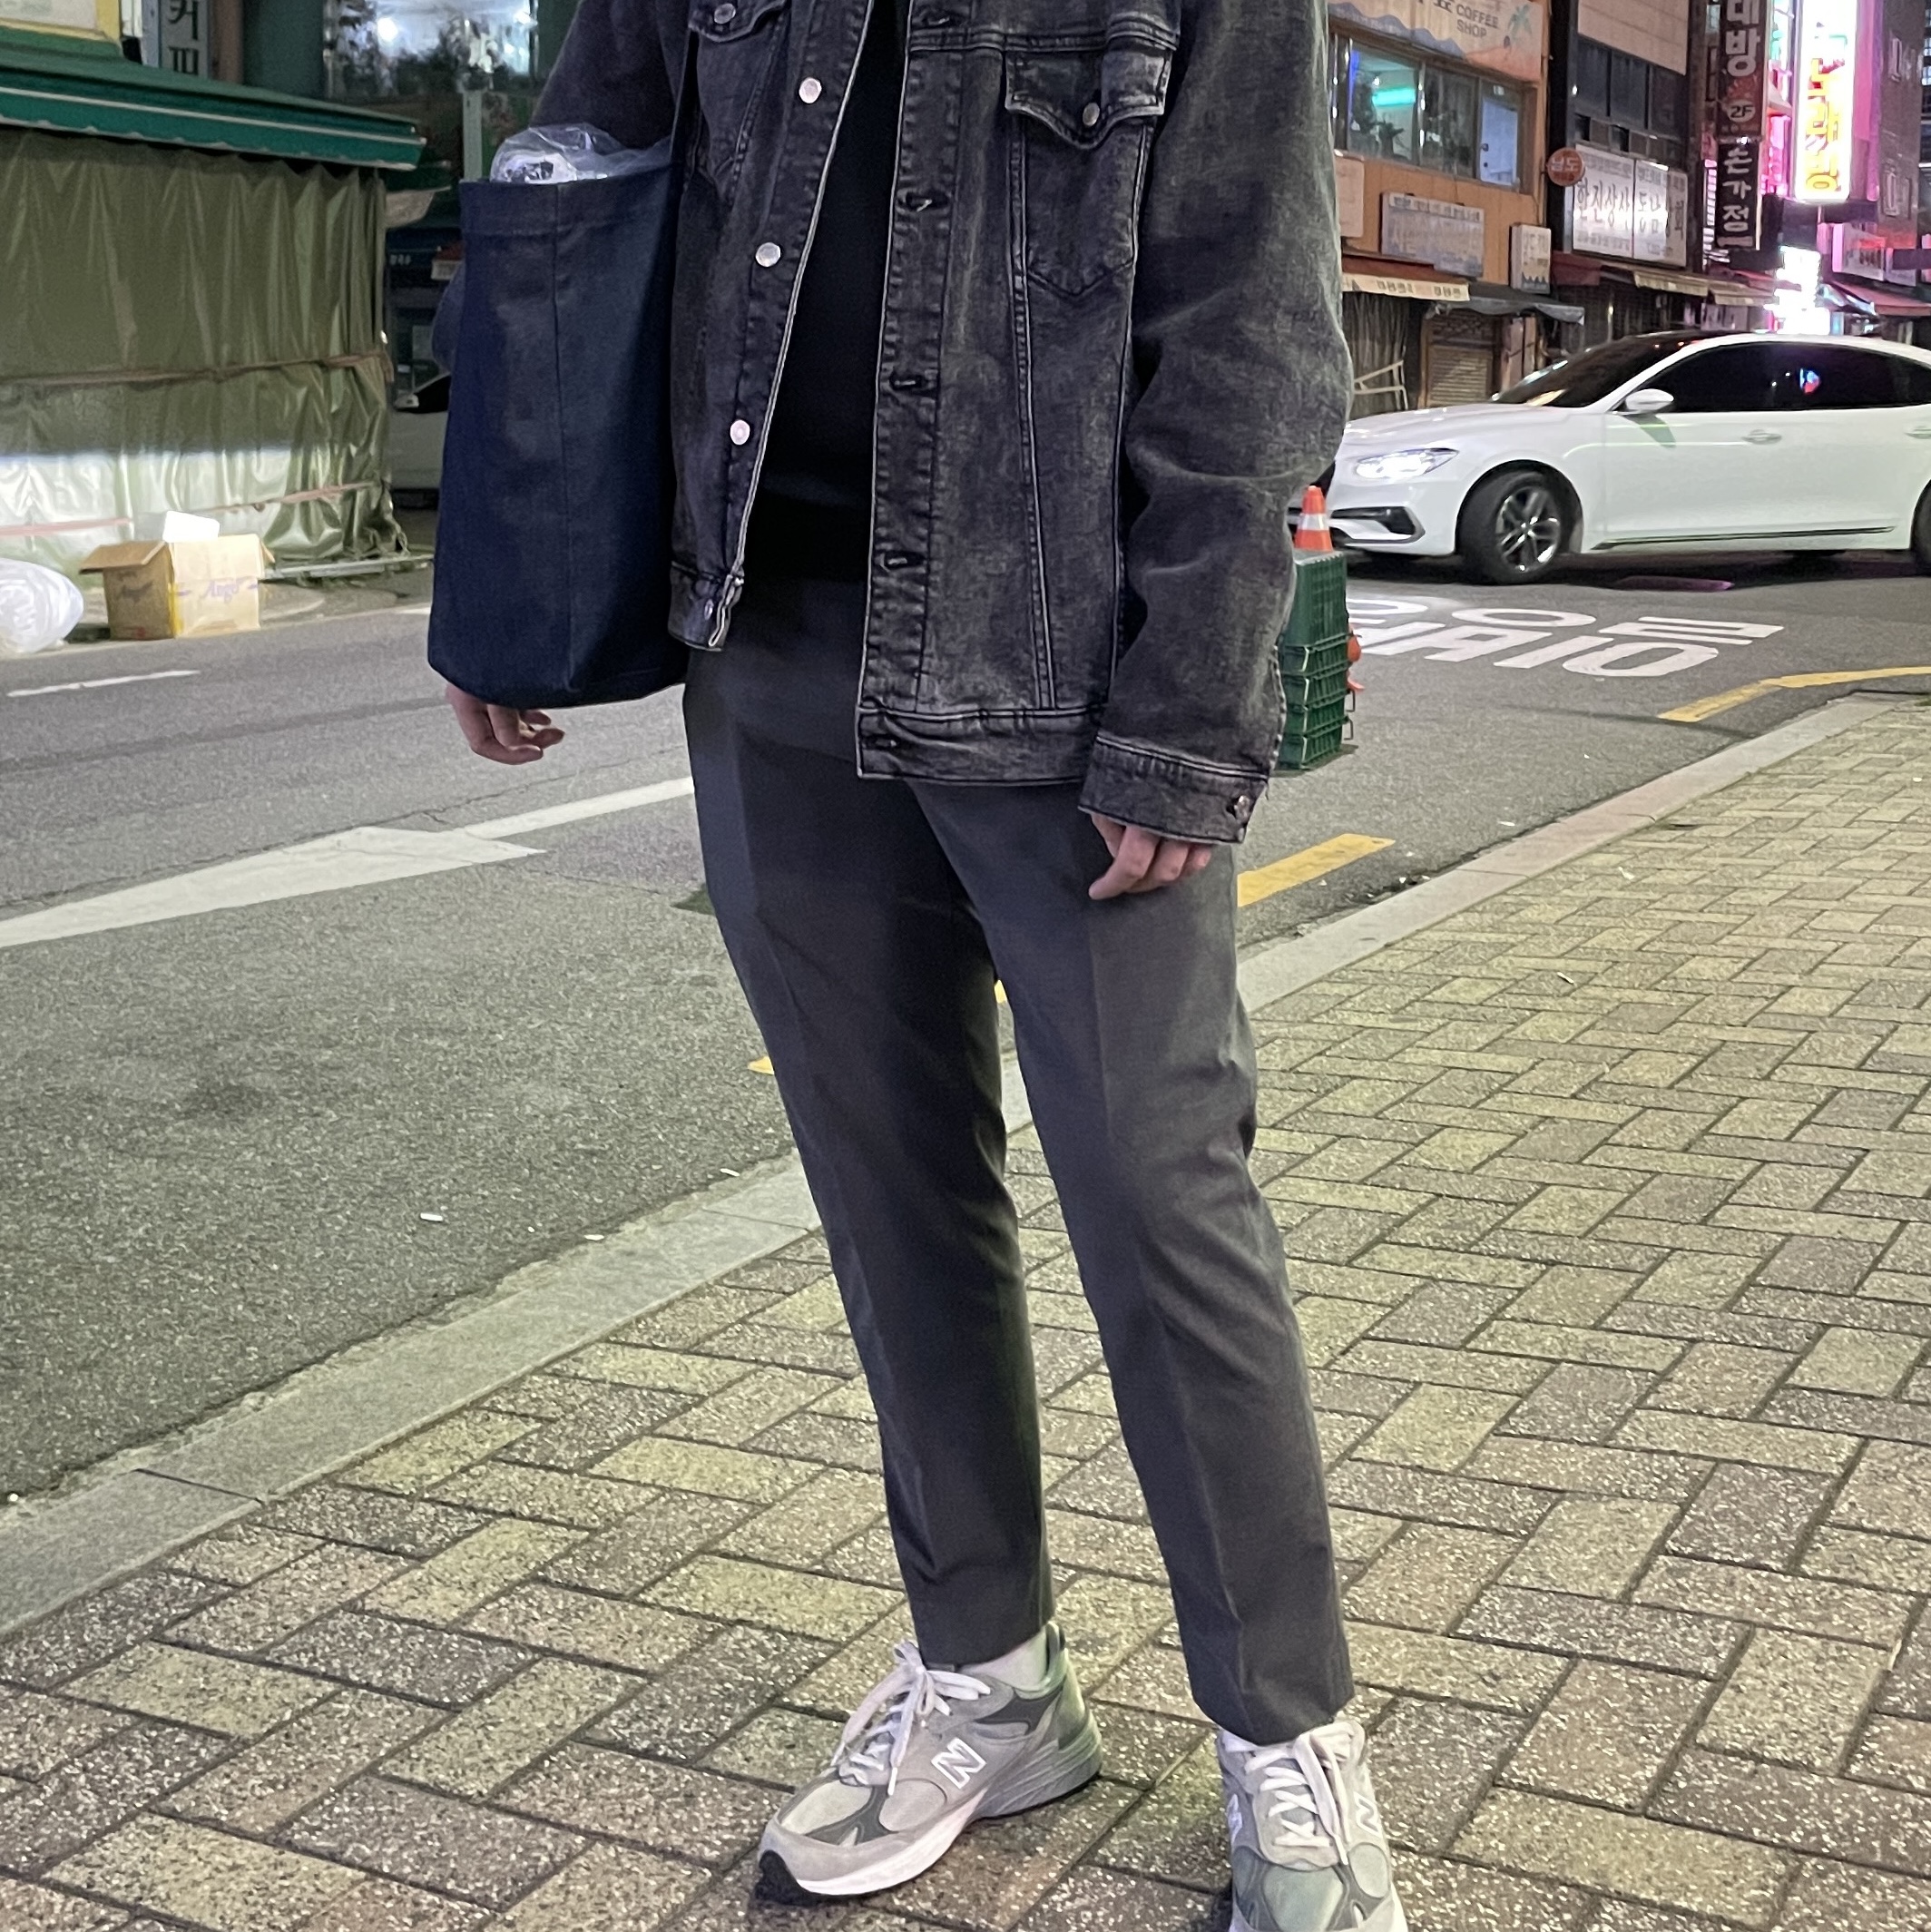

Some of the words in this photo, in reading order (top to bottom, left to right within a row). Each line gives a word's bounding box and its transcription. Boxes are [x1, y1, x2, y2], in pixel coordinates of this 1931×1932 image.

[1456, 4, 1500, 30] COFFEE
[1456, 18, 1488, 39] SHOP
[1730, 103, 1754, 119] 2F
[930, 1737, 987, 1790] N
[1352, 1790, 1383, 1839] N
